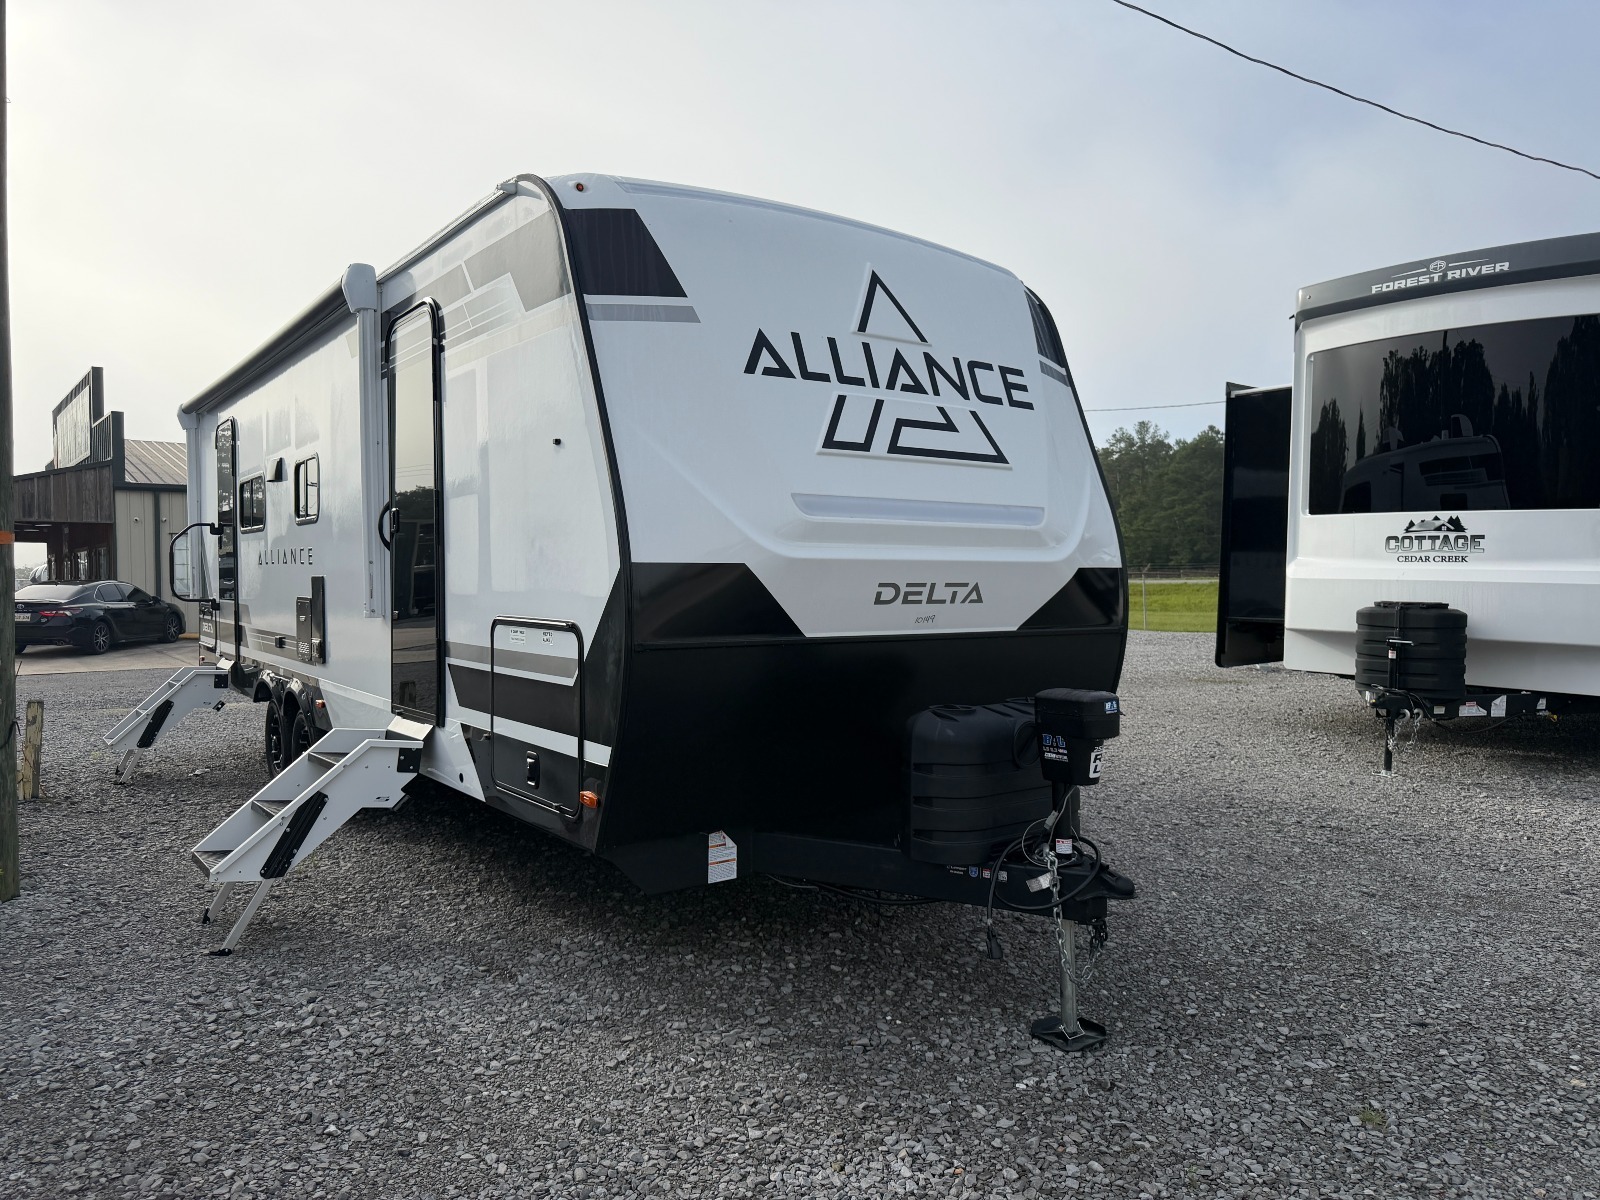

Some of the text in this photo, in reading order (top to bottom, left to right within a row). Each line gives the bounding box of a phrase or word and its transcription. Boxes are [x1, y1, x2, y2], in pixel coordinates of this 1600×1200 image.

[1371, 261, 1510, 294] FOREST RIVER
[743, 328, 1034, 410] ALLIANCE
[1384, 534, 1486, 554] COTTAGE
[258, 547, 313, 566] ALLIANCE
[1396, 555, 1469, 563] CEDAR CREEK
[873, 582, 984, 605] DELTA
